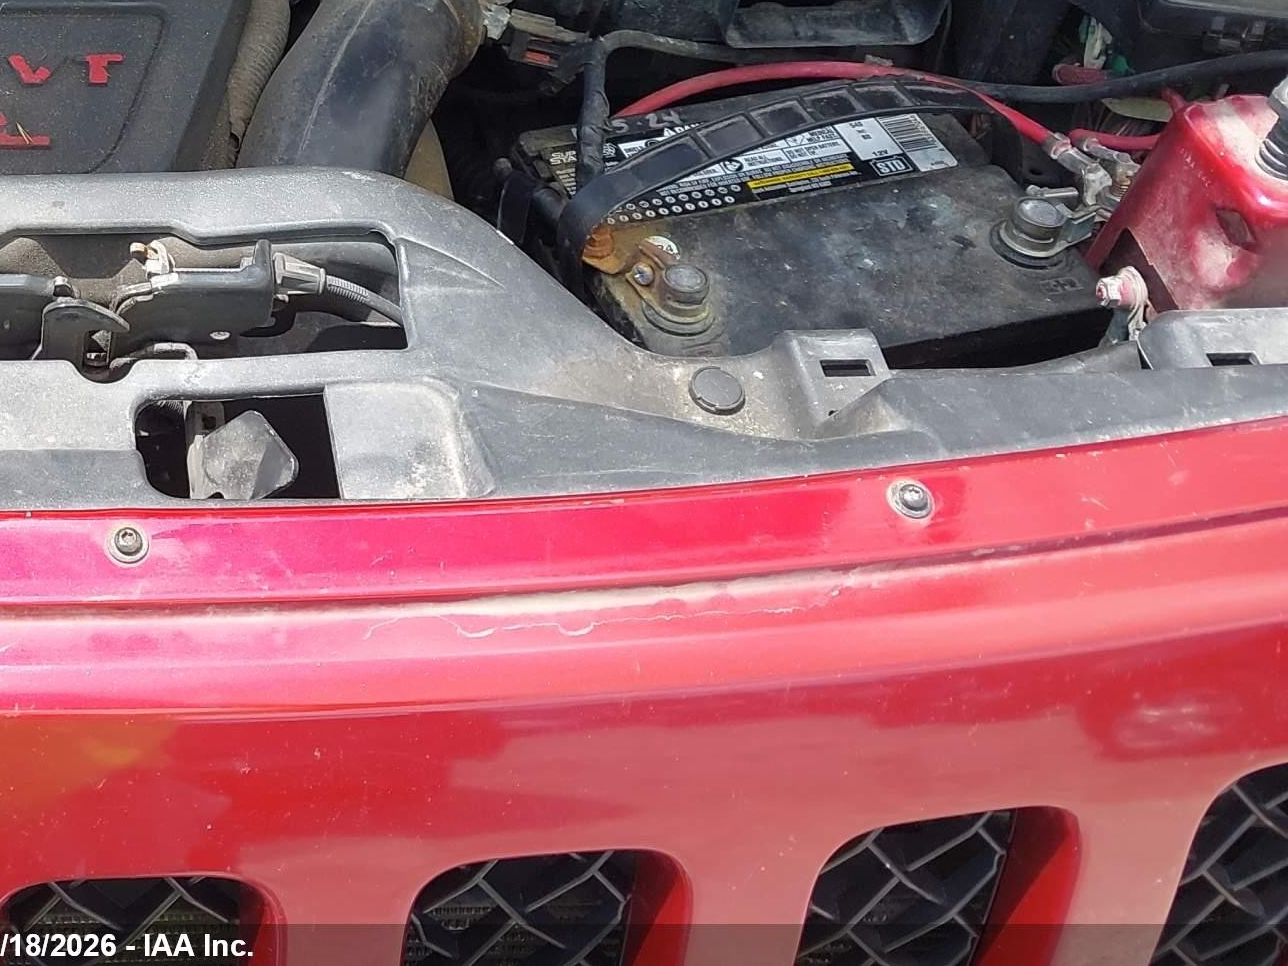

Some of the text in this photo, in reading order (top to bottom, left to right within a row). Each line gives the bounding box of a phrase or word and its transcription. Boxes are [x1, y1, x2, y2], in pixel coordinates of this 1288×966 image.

[551, 150, 577, 159] SUP
[549, 156, 578, 165] STA
[876, 159, 906, 173] STD
